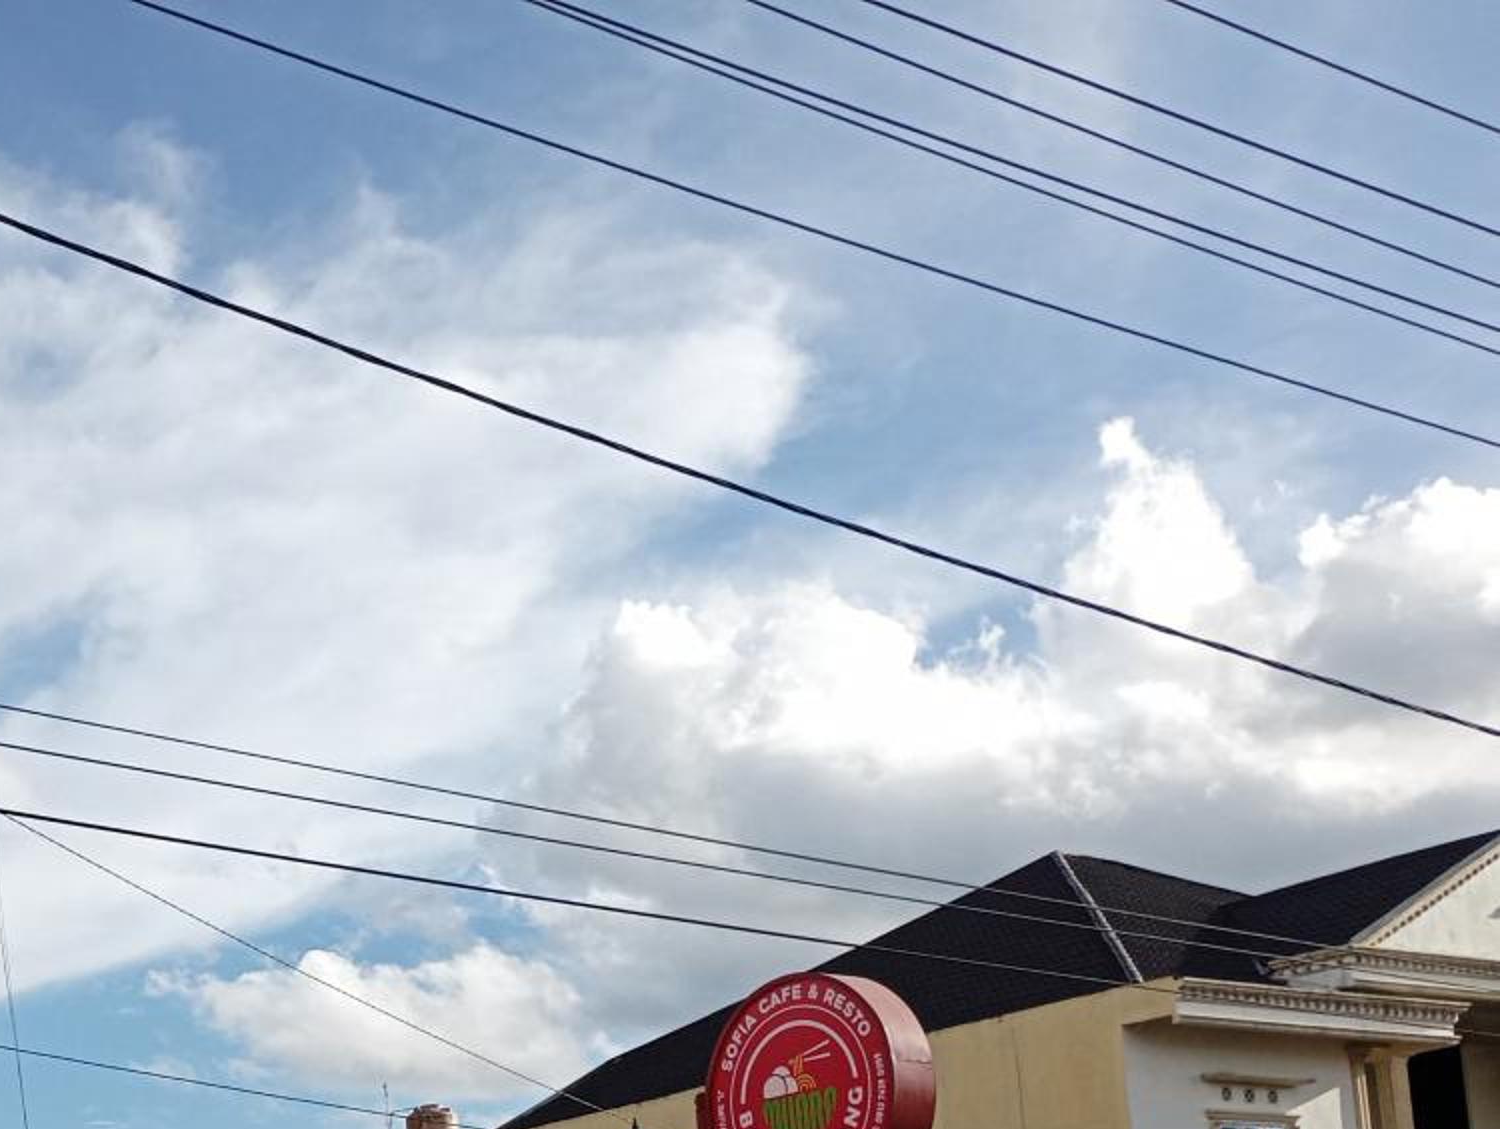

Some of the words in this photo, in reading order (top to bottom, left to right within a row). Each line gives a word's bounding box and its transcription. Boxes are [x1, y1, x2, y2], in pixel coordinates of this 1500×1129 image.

[721, 1014, 757, 1073] SOFIA
[758, 984, 802, 1014] CAFE
[807, 984, 819, 1000] &
[822, 988, 873, 1038] RESTO
